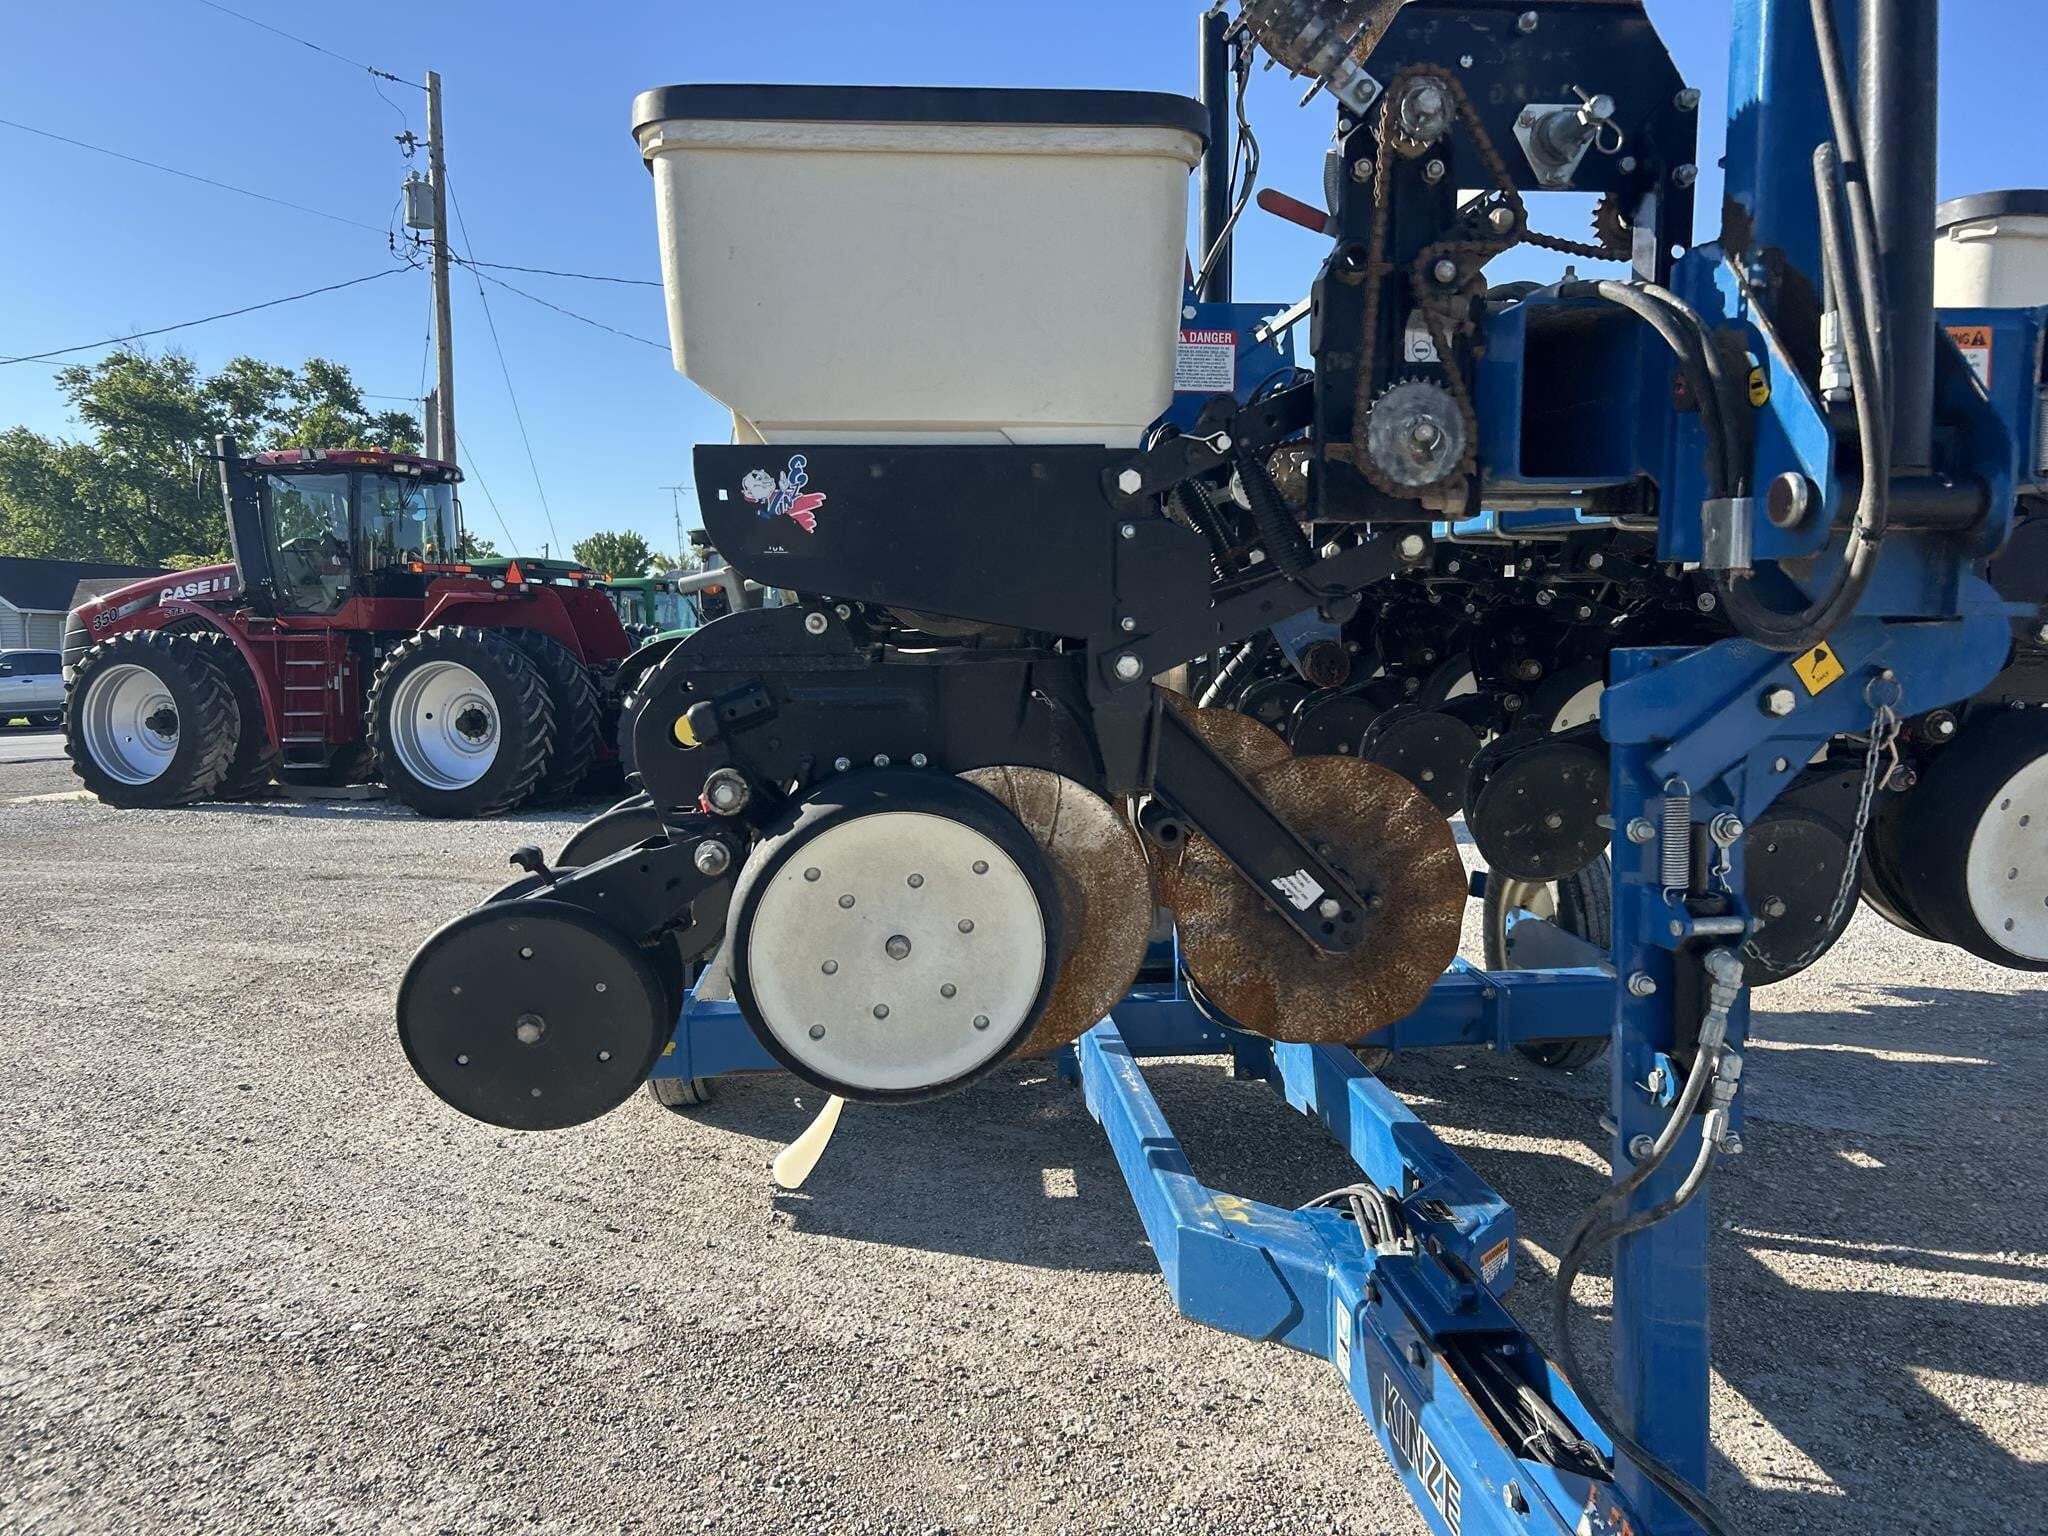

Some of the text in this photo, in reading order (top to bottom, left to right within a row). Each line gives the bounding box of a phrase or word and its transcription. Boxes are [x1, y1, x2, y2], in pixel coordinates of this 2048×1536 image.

[1190, 331, 1232, 344] DANGER
[160, 581, 211, 601] CASE
[93, 606, 119, 632] 350
[1384, 1372, 1461, 1536] KINZE
